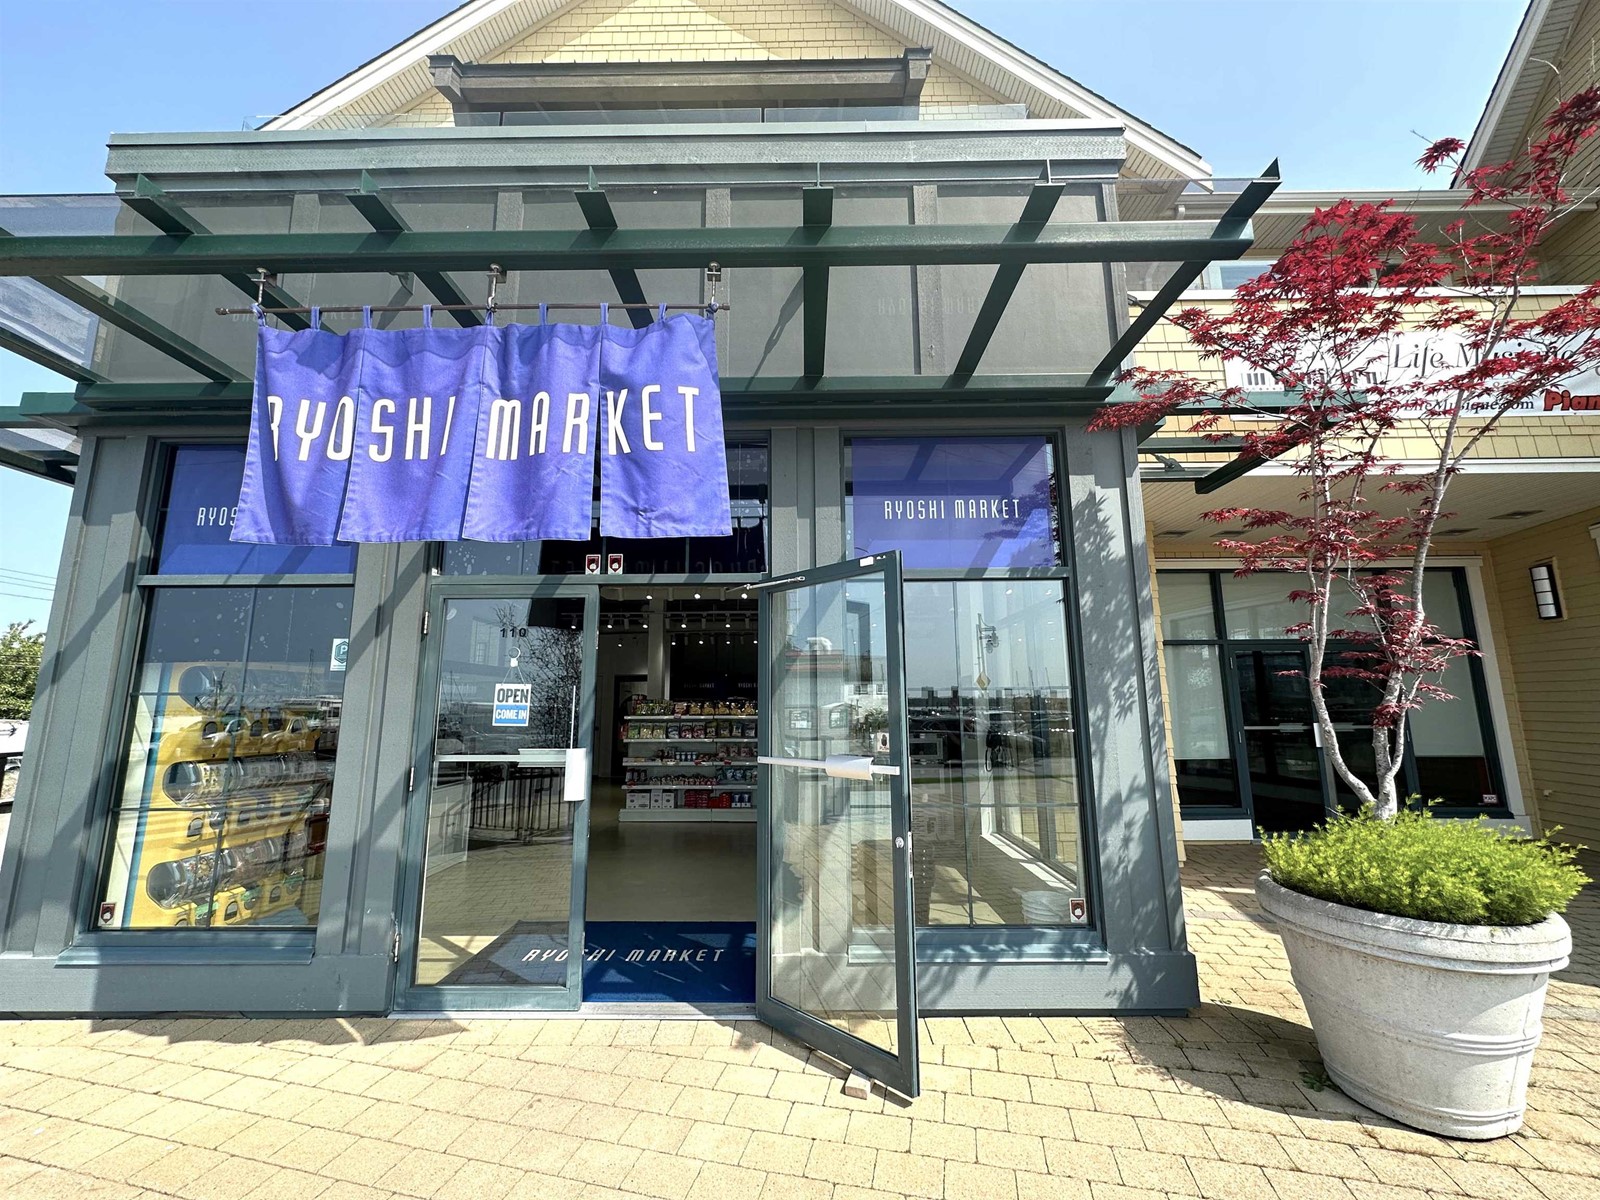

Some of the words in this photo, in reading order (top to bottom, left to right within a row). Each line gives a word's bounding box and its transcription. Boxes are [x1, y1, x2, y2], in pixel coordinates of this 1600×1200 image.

[1391, 339, 1444, 379] Life
[267, 395, 456, 462] RYOSHI
[485, 384, 700, 460] MARKET
[884, 500, 945, 519] RYOSHI
[954, 499, 1020, 518] MARKET
[500, 627, 527, 638] 110
[496, 688, 530, 704] OPEN
[495, 709, 518, 720] COME
[518, 709, 527, 720] IN
[625, 948, 724, 962] MARKET
